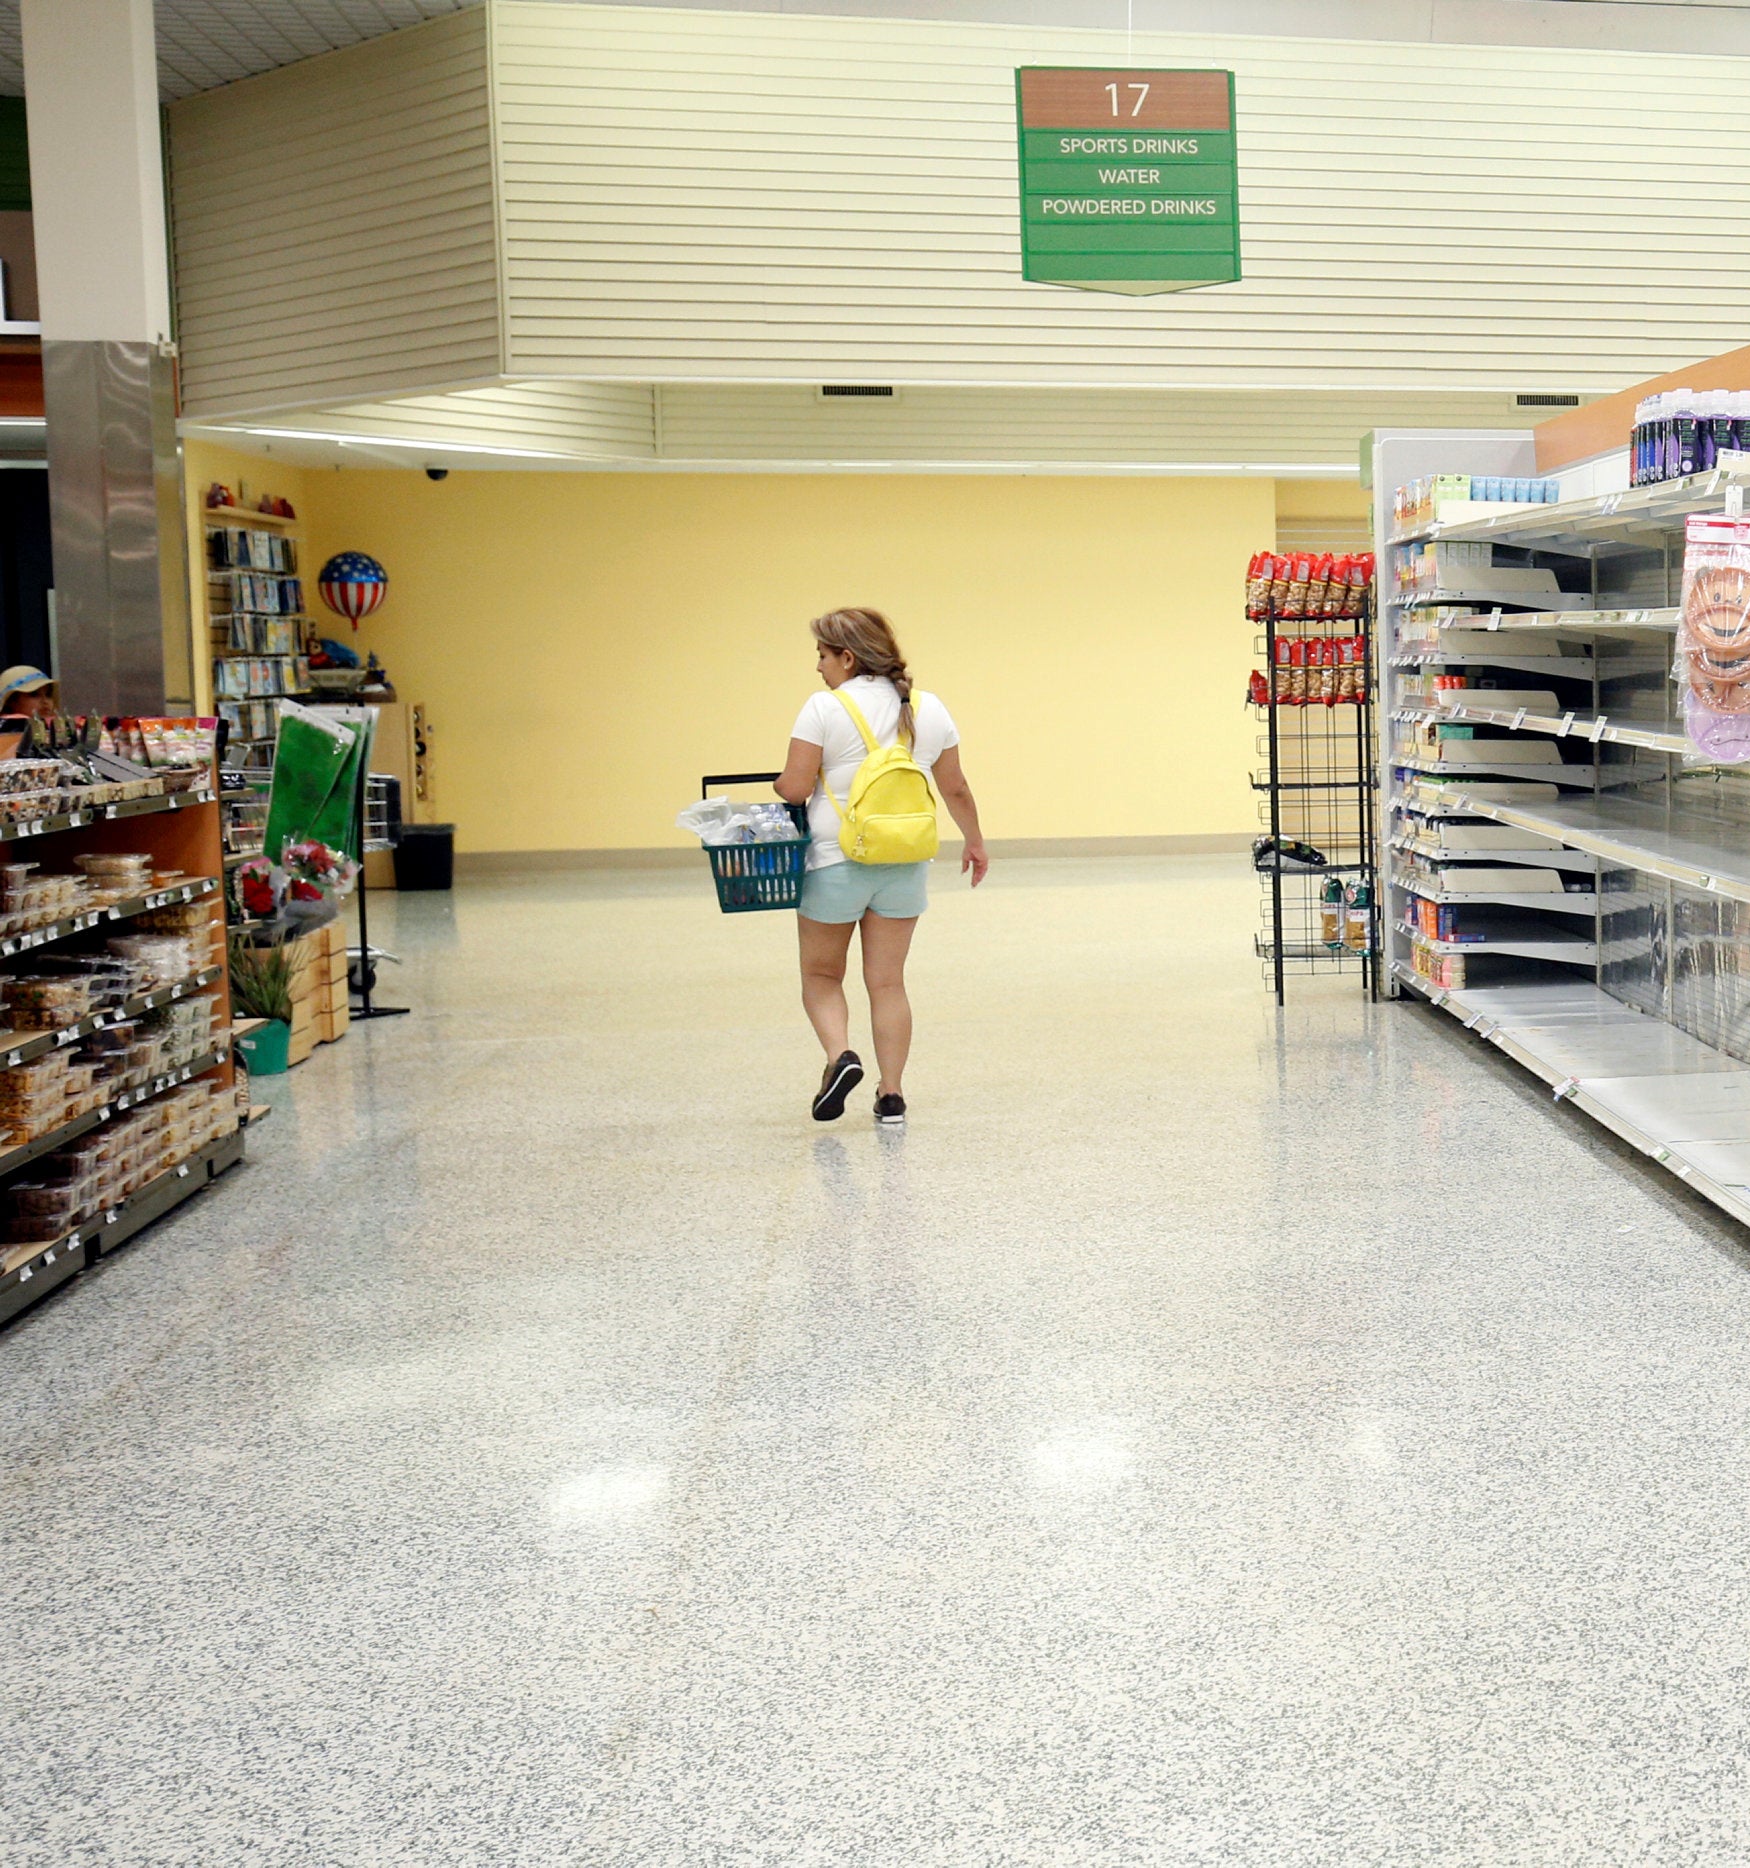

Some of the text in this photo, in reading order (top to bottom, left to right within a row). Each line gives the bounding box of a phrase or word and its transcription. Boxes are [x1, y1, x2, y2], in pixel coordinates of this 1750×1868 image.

[1105, 83, 1150, 117] 17
[1060, 137, 1198, 154] SPORTS DRINKS
[1098, 168, 1160, 184] WATER
[1042, 199, 1216, 215] POWDERED DRINKS
